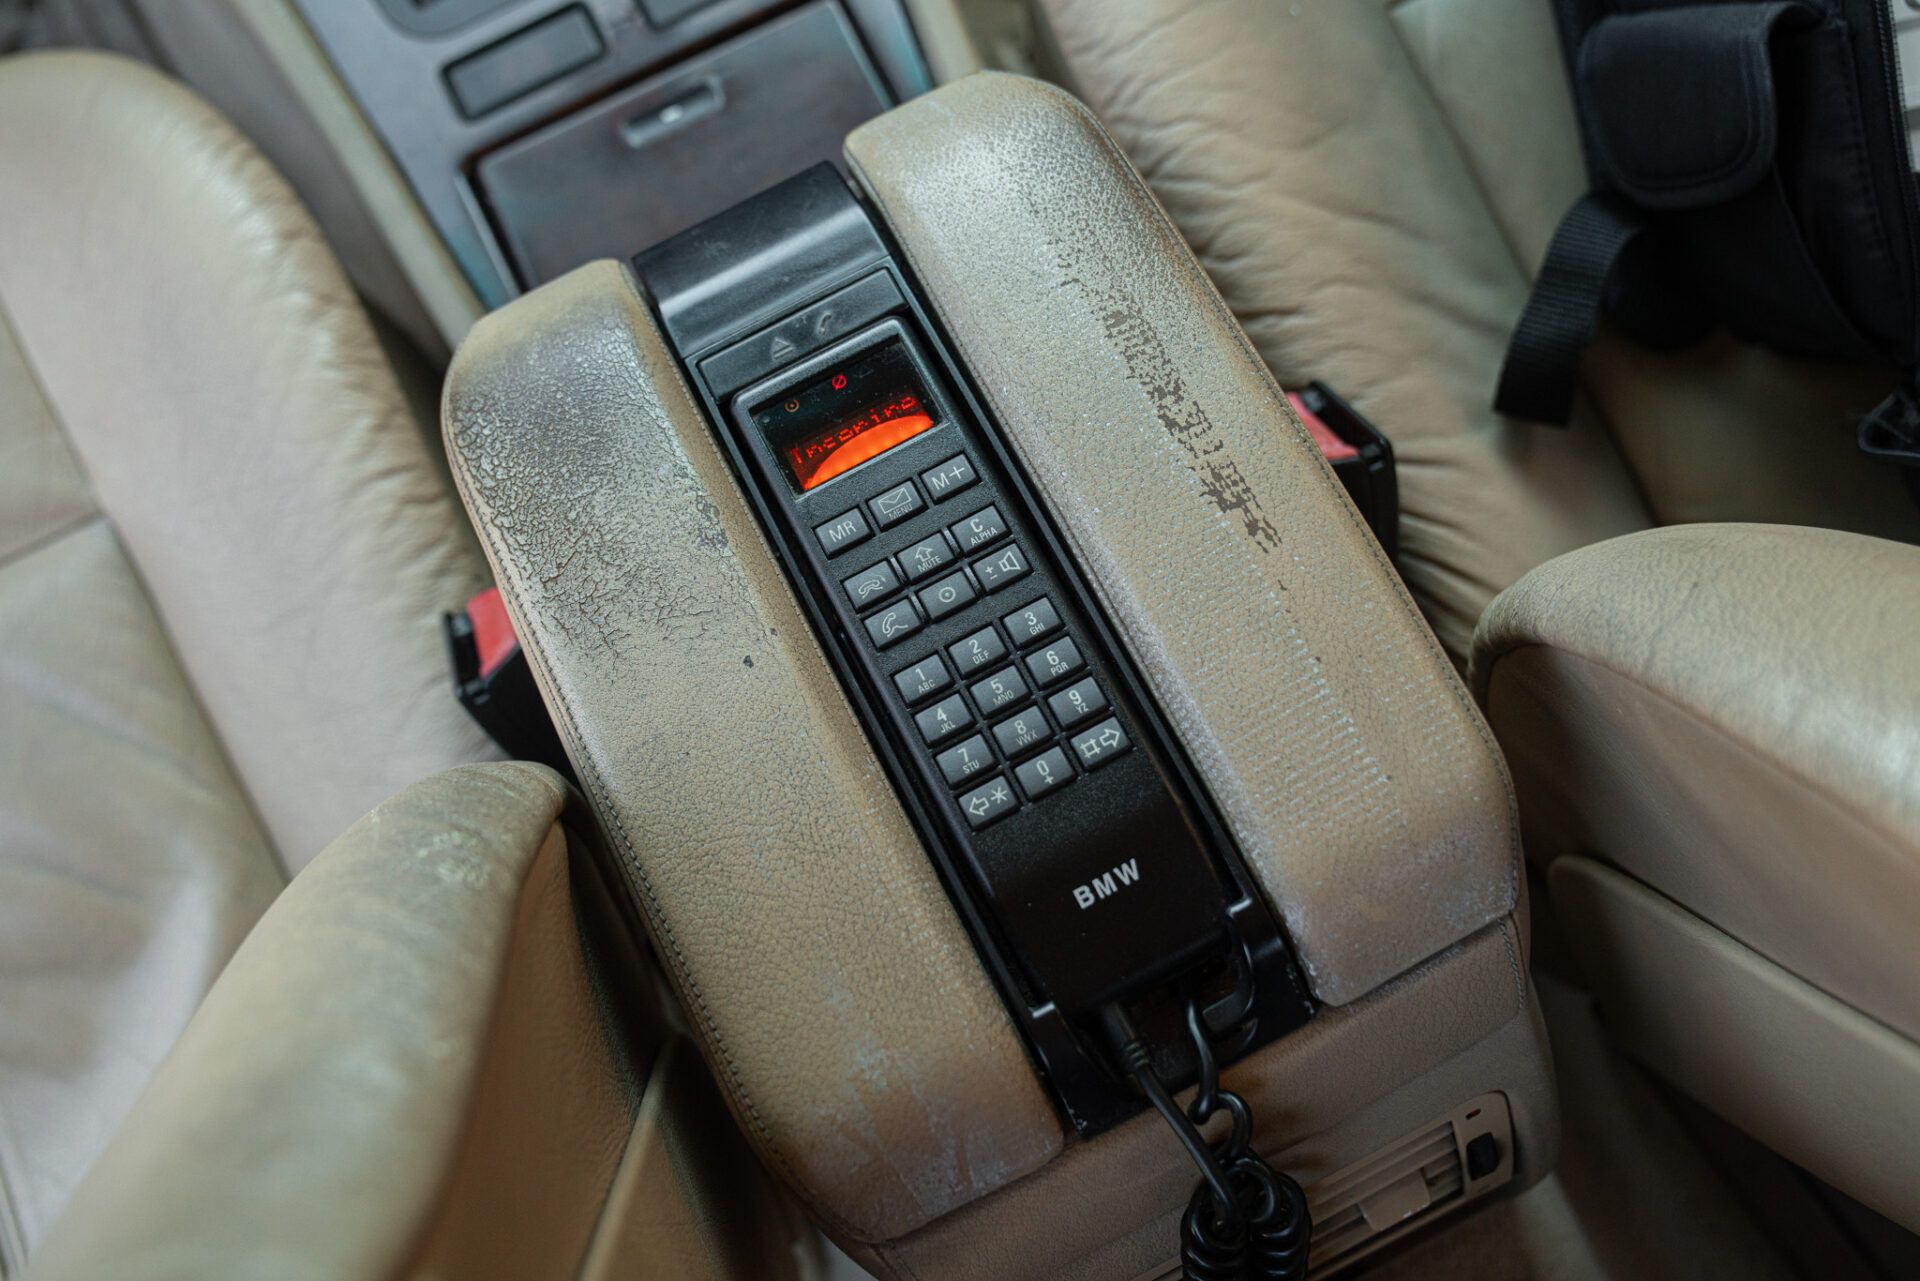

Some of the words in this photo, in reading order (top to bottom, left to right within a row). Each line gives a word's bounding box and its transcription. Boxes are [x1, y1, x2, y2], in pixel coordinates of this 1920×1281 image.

[888, 503, 913, 520] MENU
[829, 520, 857, 543] MR
[970, 518, 984, 533] C
[970, 526, 998, 546] ALPHA
[918, 555, 942, 572] MUTE
[1024, 611, 1038, 626] 3
[1029, 623, 1046, 636] GHI
[968, 639, 982, 654] 2
[972, 650, 990, 665] DEF
[1046, 650, 1060, 665] 6
[915, 667, 927, 682] 1
[1050, 661, 1069, 677] PQR
[917, 679, 936, 694] ABC
[990, 678, 1004, 694] 5
[993, 690, 1015, 706] MNO
[1068, 689, 1083, 706] 9
[936, 707, 948, 722] 4
[1075, 703, 1089, 715] YZ
[940, 720, 956, 734] JKL
[1014, 719, 1027, 735] 8
[1016, 731, 1039, 747] VWX
[957, 747, 970, 763] 7
[962, 759, 980, 775] STU
[1036, 760, 1050, 776] 0
[1072, 858, 1140, 909] BMW
